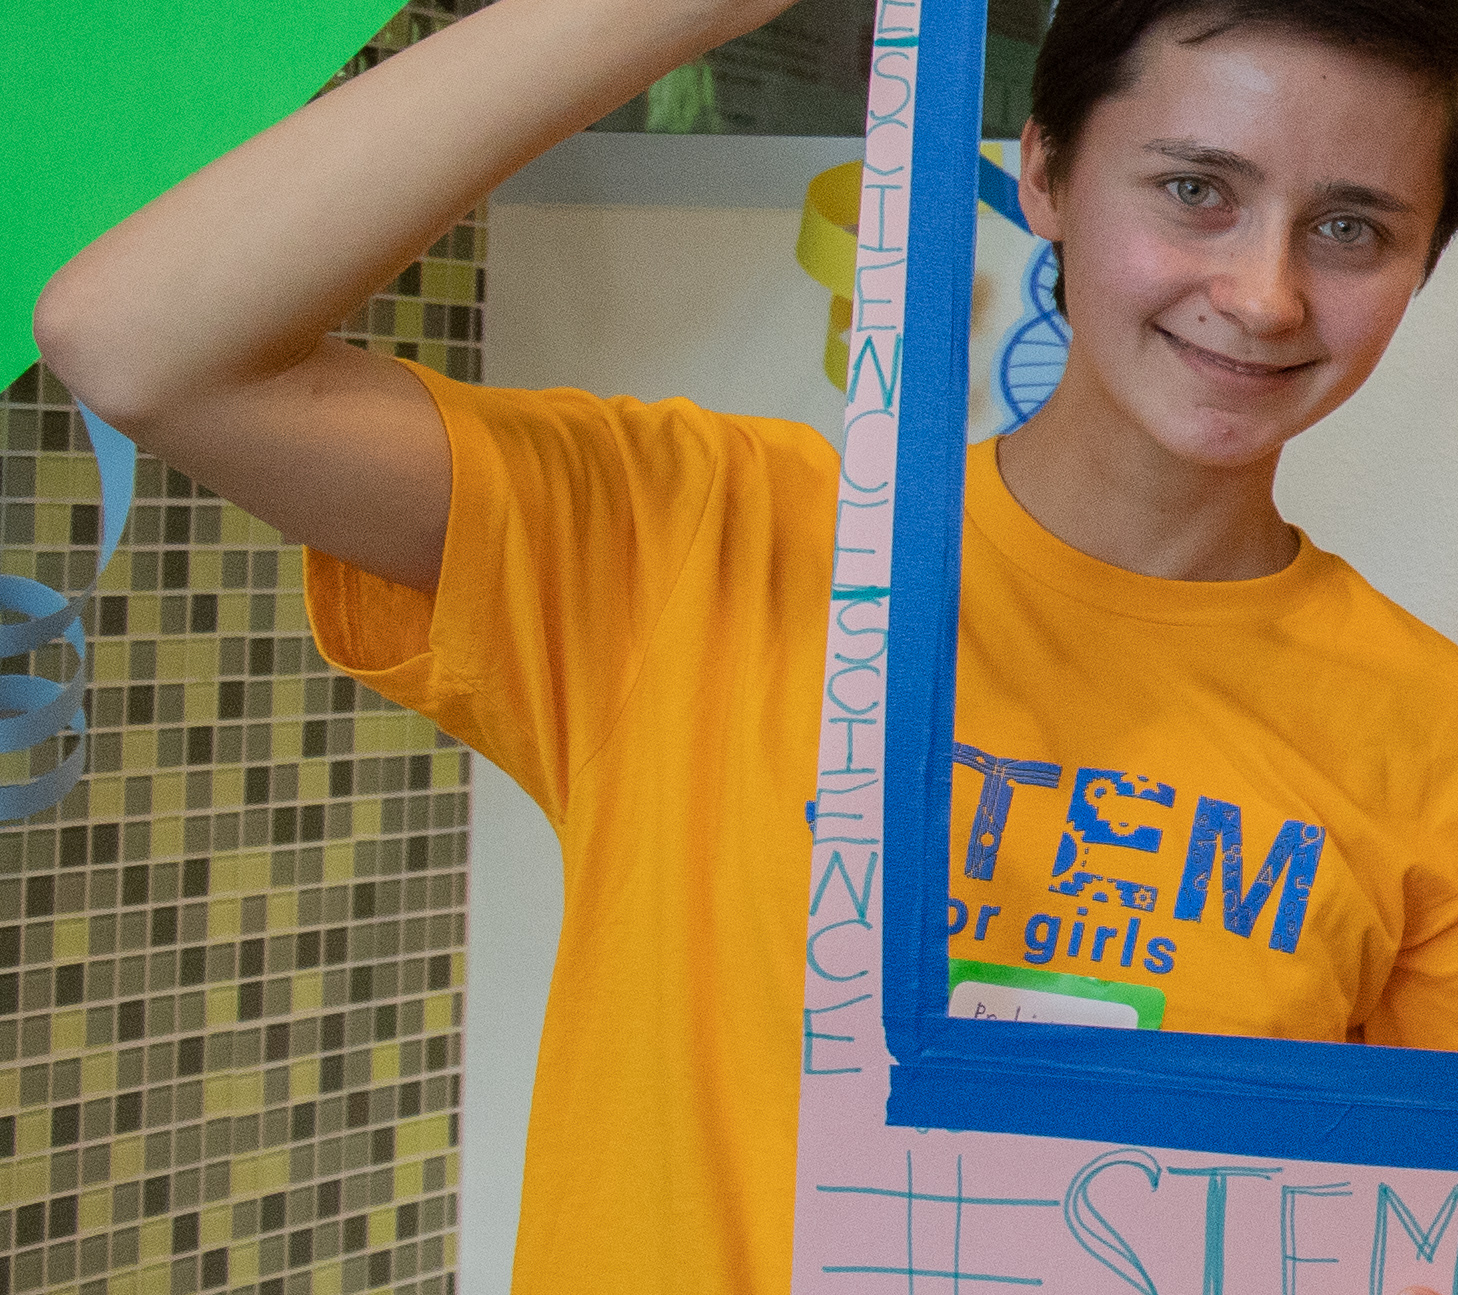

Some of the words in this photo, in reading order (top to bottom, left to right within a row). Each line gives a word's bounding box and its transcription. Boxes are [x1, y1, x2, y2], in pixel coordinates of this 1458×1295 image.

[833, 51, 914, 588] SCIENCE
[804, 597, 888, 1074] SCIENCE
[948, 898, 1000, 941] or
[1024, 905, 1178, 974] girls
[953, 741, 1326, 954] TEM
